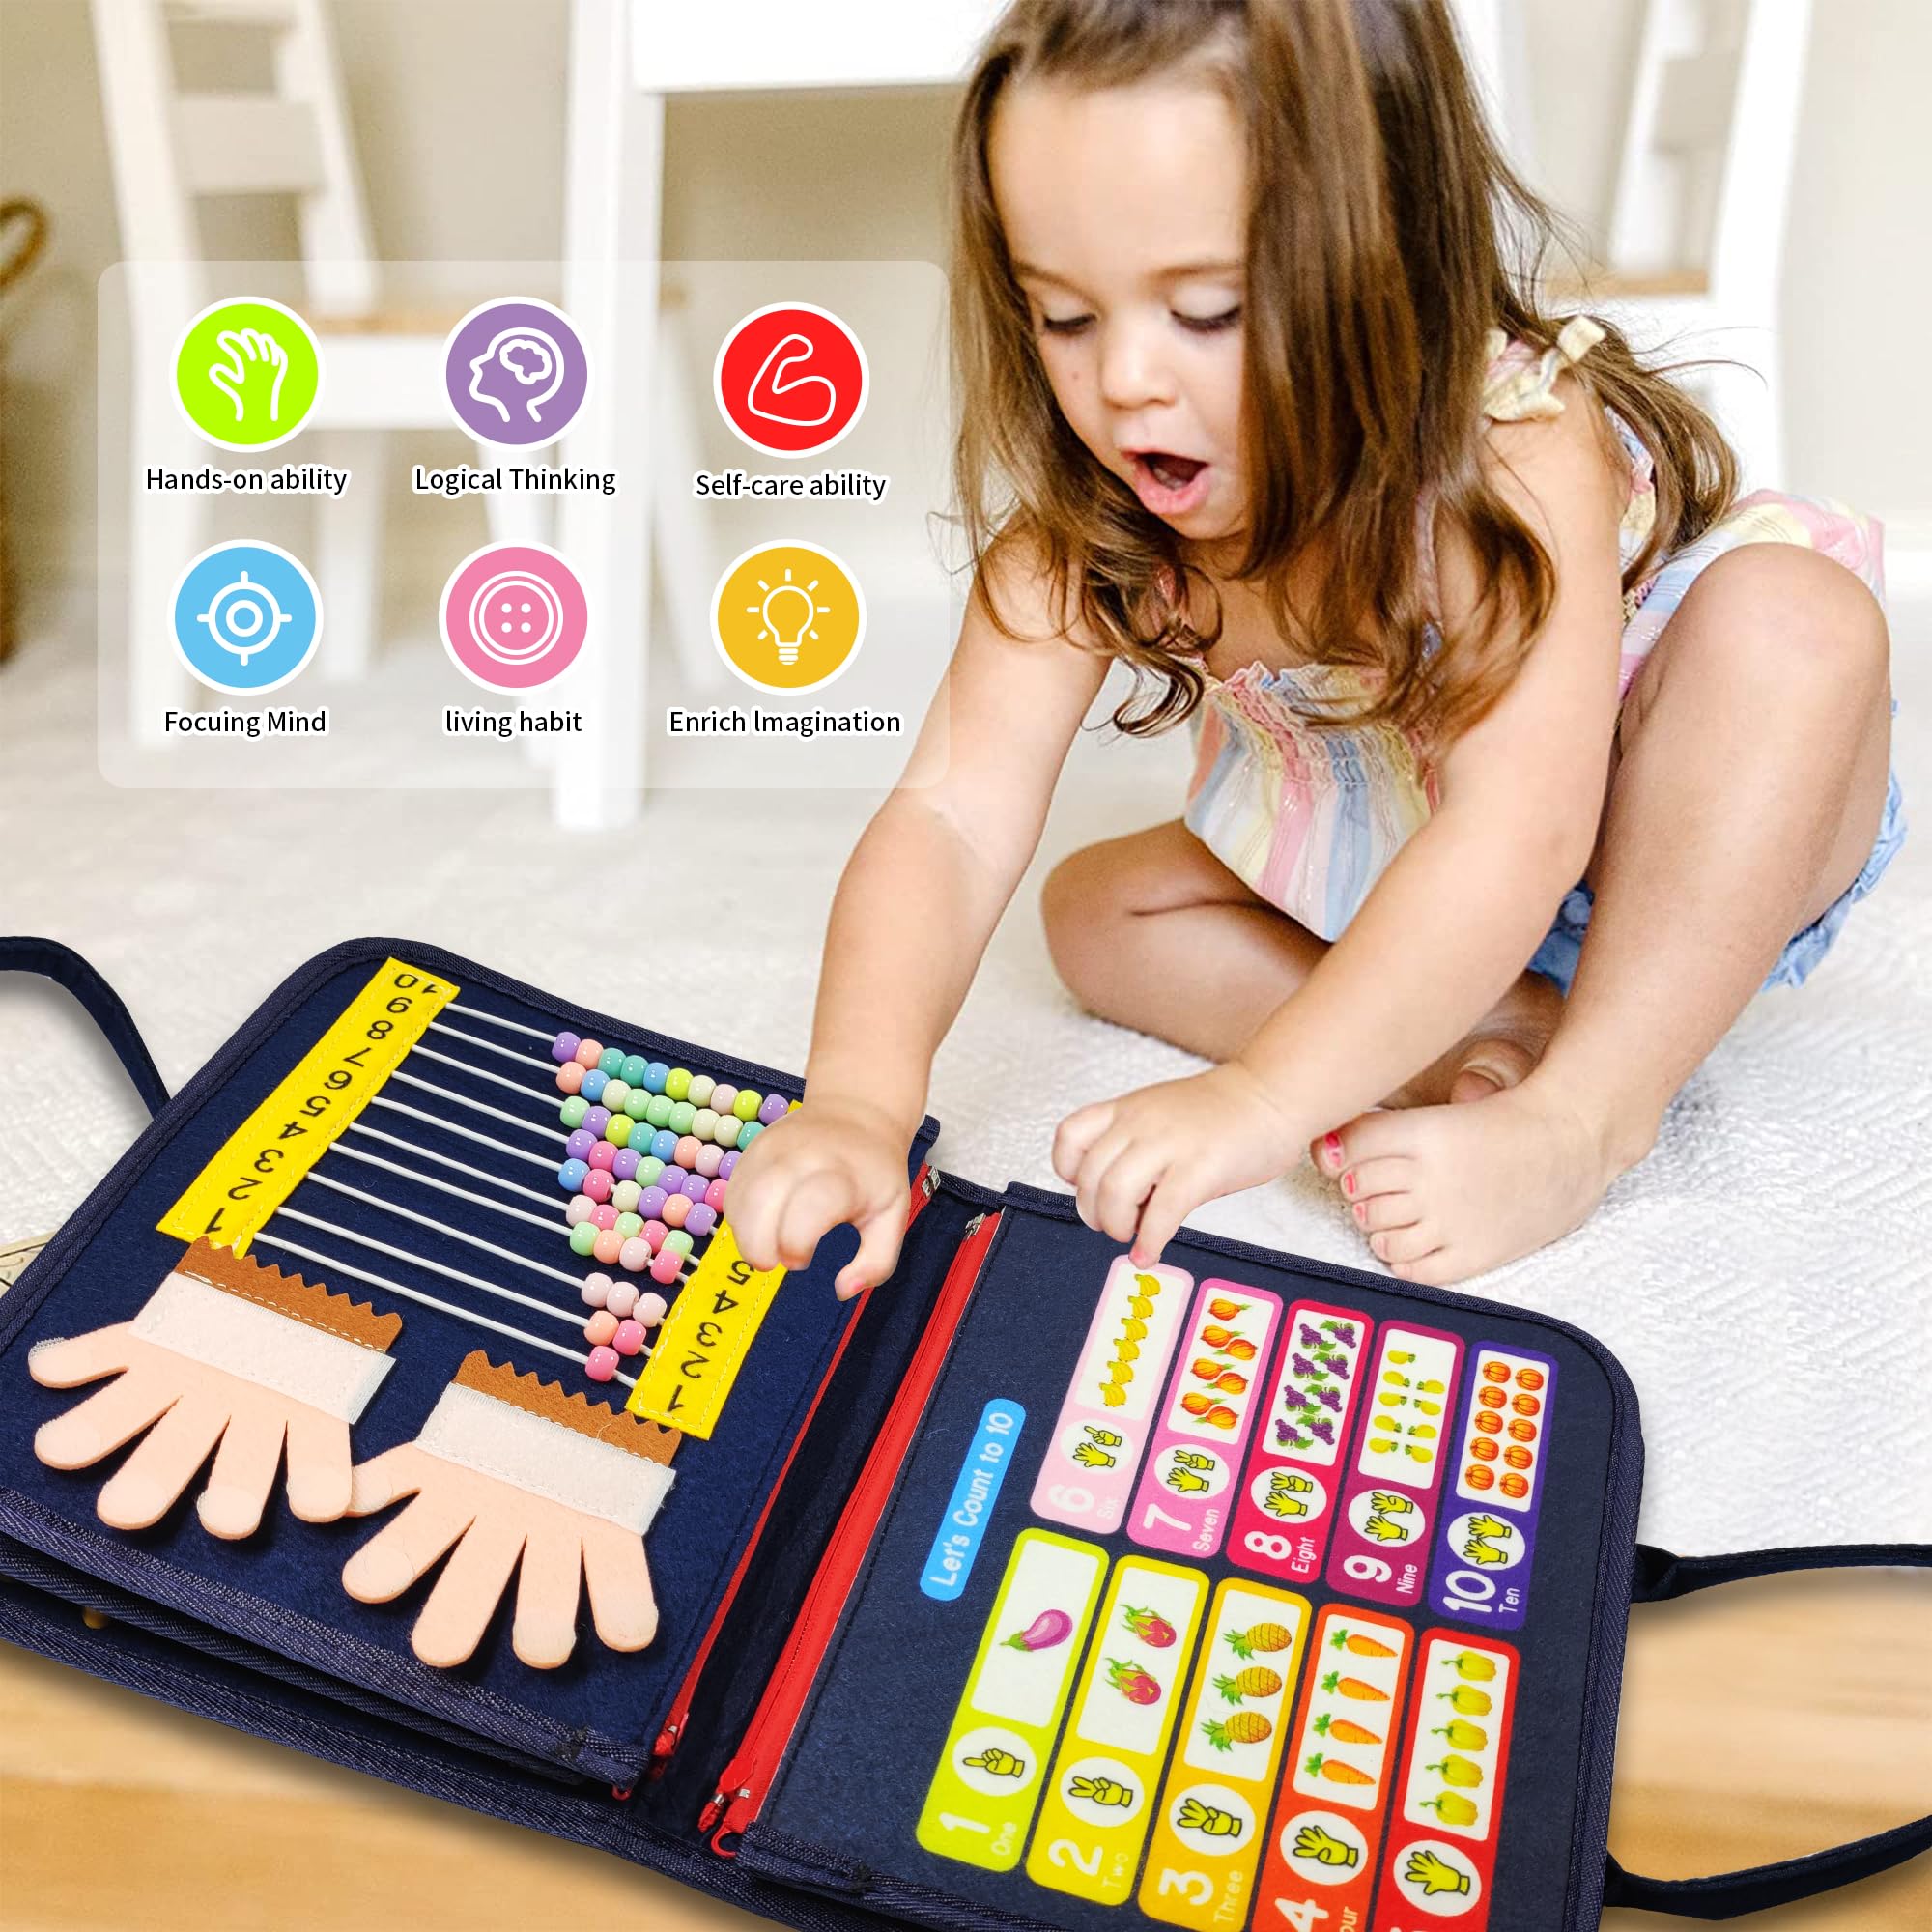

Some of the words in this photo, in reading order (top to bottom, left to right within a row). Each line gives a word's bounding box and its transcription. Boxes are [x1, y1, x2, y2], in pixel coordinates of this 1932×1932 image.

[366, 1020, 394, 1040] 8
[343, 1047, 371, 1067] 7
[299, 1095, 331, 1117] 5
[278, 1121, 308, 1140] 4
[253, 1148, 285, 1173] 3
[228, 1177, 263, 1201] 2
[204, 1208, 226, 1235] 1
[726, 1260, 755, 1286] 5
[712, 1289, 739, 1315] 4
[696, 1321, 723, 1348] 3
[680, 1350, 710, 1379] 2
[667, 1384, 685, 1412] 1
[985, 1412, 1015, 1435] 10
[979, 1442, 1005, 1463] to
[952, 1467, 994, 1527] Count
[1048, 1483, 1095, 1515] 6
[1142, 1502, 1192, 1533] 7
[1192, 1507, 1221, 1552] Seven
[928, 1533, 971, 1586] Let's
[1243, 1530, 1293, 1561] 8
[1291, 1536, 1317, 1574] Eight
[1342, 1554, 1393, 1583] 9
[1395, 1563, 1419, 1595] Nine
[1442, 1570, 1497, 1614] 10
[1498, 1587, 1520, 1614] Ten
[938, 1811, 991, 1834] 1
[991, 1822, 1018, 1857] One
[1047, 1838, 1104, 1877] 2
[1102, 1852, 1129, 1888] Two
[1158, 1867, 1214, 1907] 3
[1213, 1869, 1243, 1923] Three
[1274, 1897, 1330, 1932] 4
